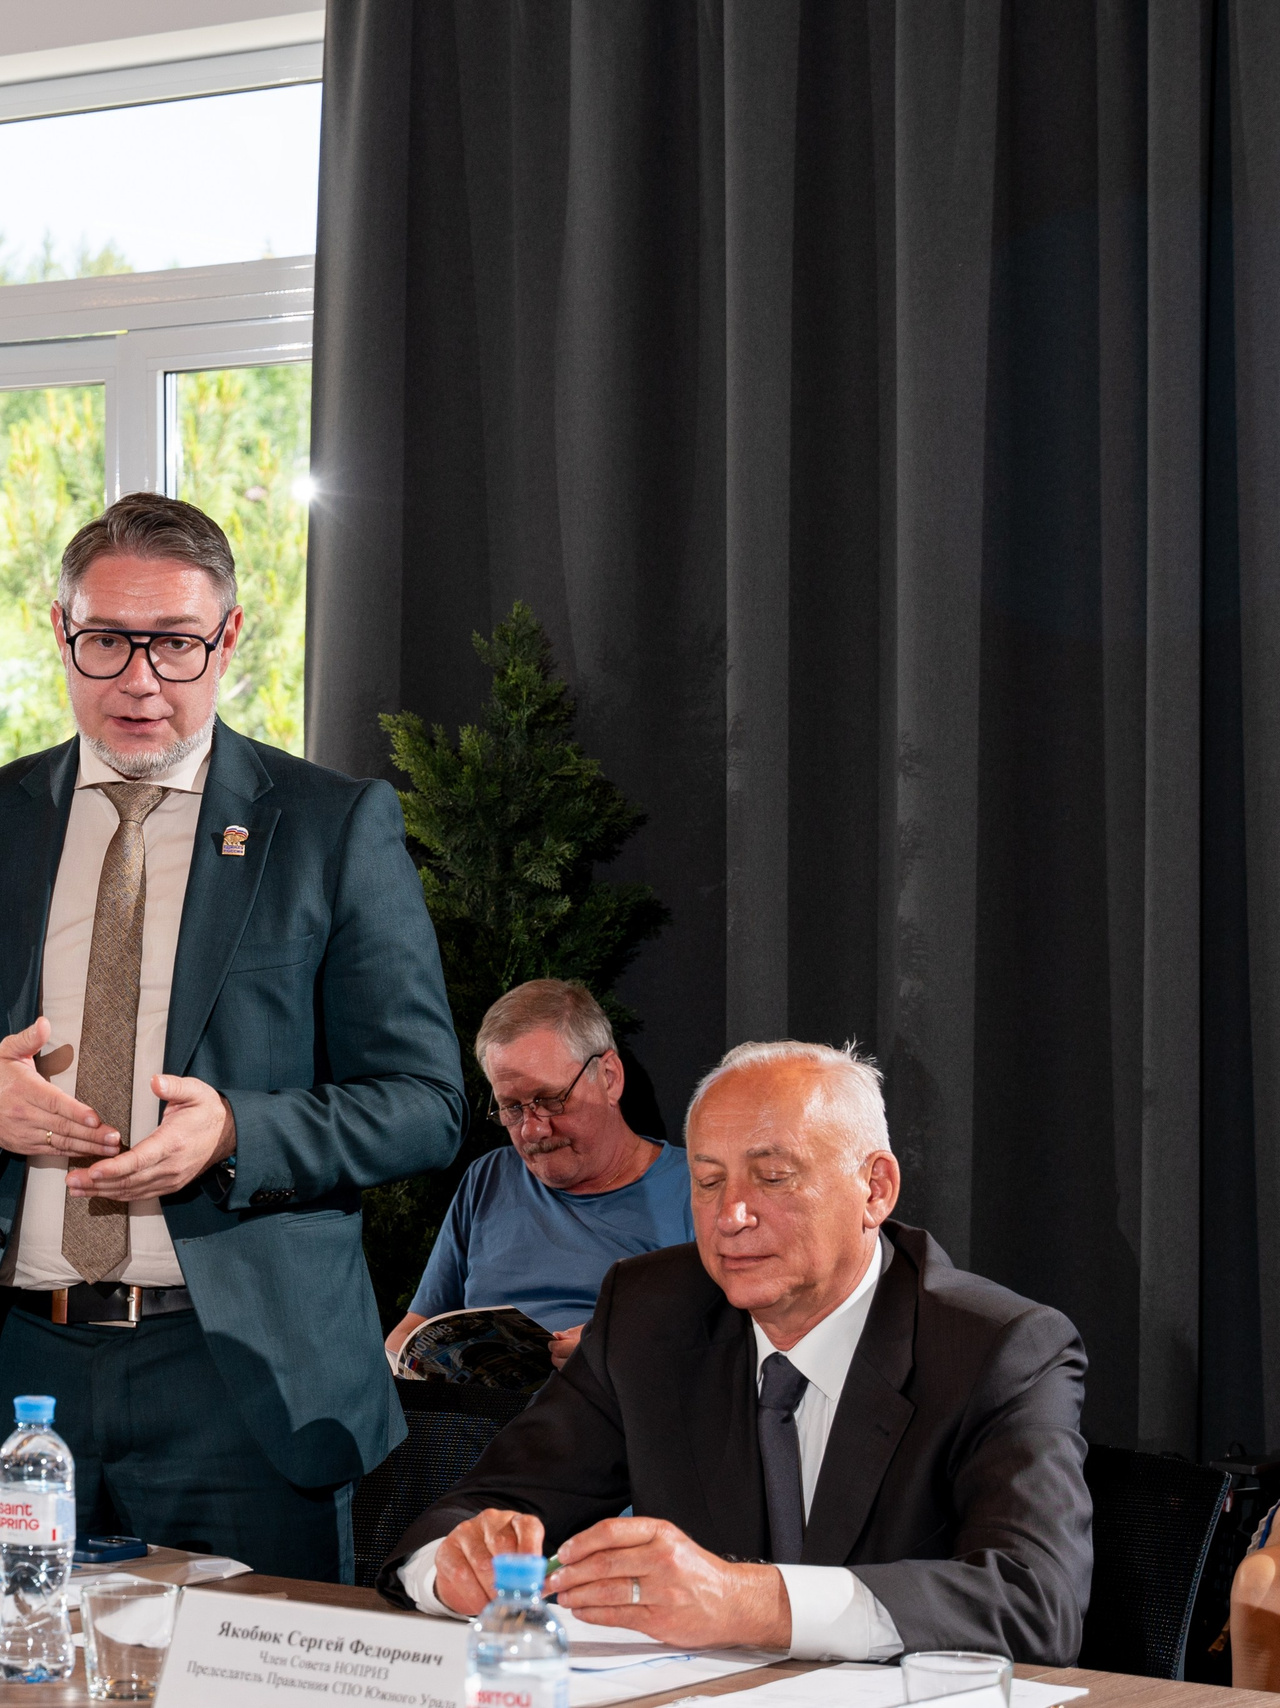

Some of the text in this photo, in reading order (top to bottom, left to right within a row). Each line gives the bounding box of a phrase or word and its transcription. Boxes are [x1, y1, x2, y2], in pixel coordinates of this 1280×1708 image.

[409, 1324, 453, 1359] НОПРИЗ
[217, 1621, 444, 1666] Якобюк Сергей Федорович
[187, 1660, 263, 1683] Председатель
[266, 1671, 329, 1693] Правления
[331, 1680, 362, 1695] СПО
[363, 1685, 417, 1705] Южного
[259, 1649, 389, 1680] Член Совета НОПРИЗ
